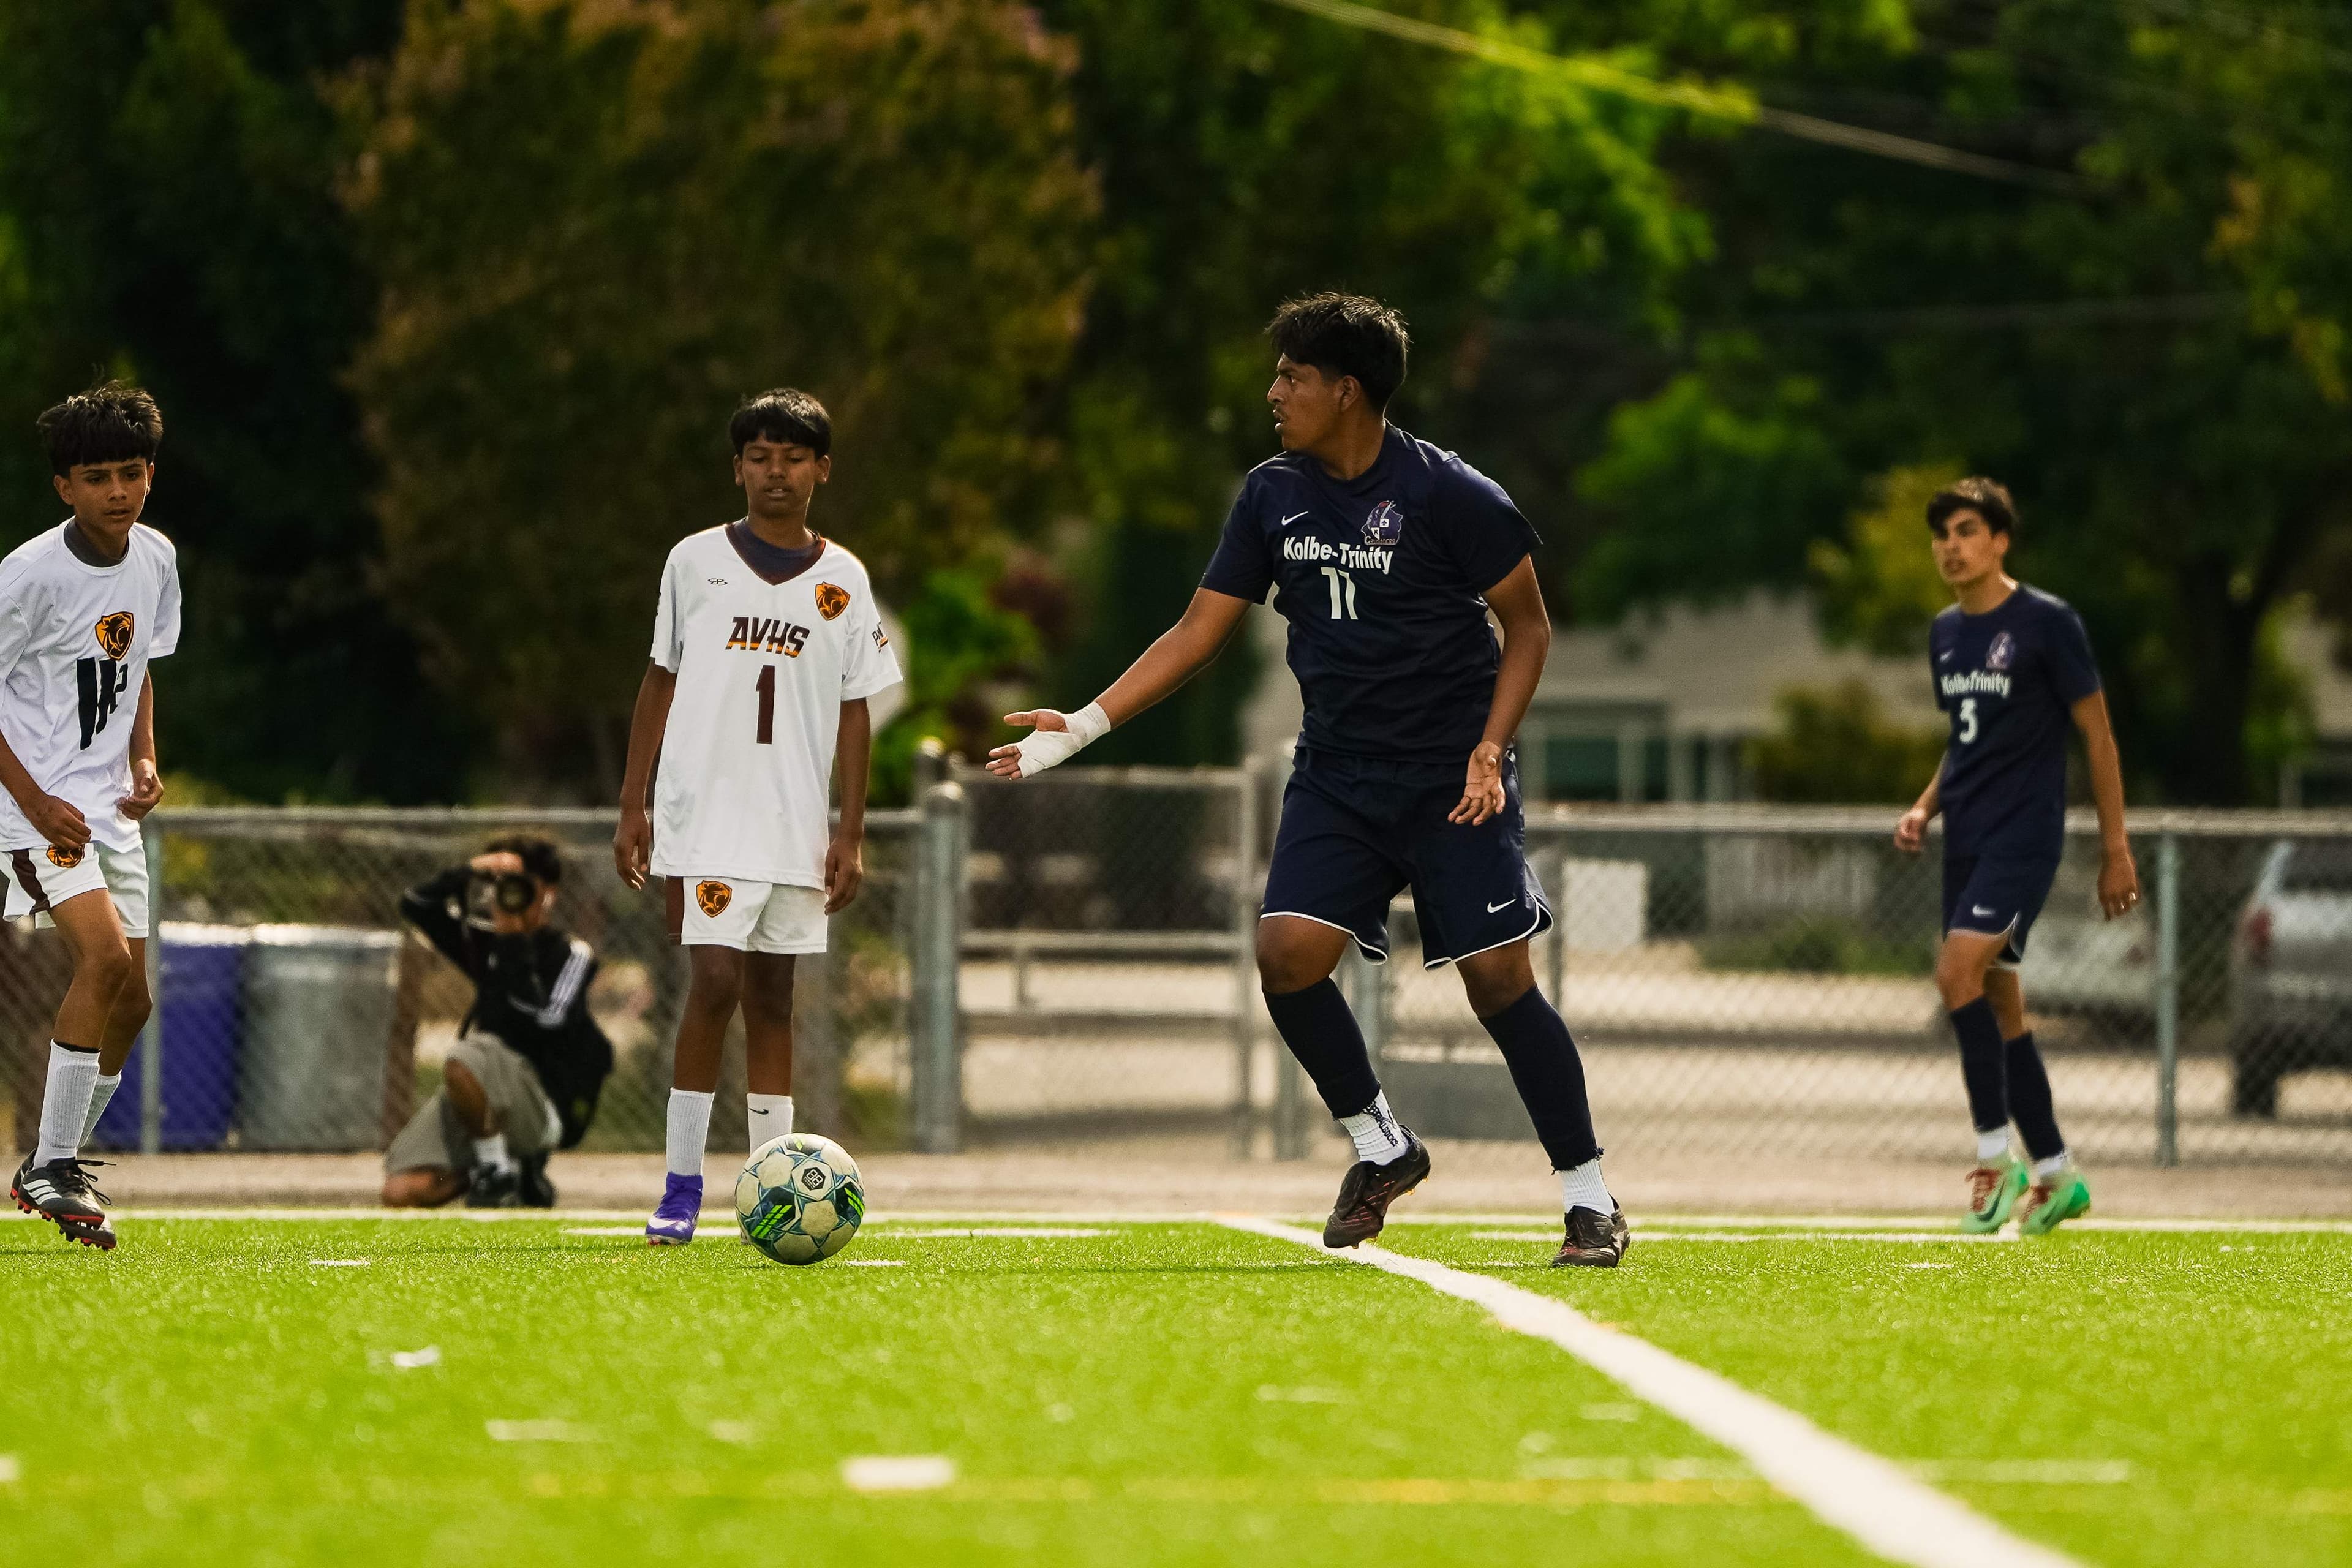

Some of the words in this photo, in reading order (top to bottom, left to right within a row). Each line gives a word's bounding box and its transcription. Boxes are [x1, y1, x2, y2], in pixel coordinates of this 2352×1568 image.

[1283, 535, 1393, 575] Kolbe-Trinity
[1321, 567, 1359, 620] 11
[725, 616, 810, 658] AVHS
[755, 665, 775, 745] 1
